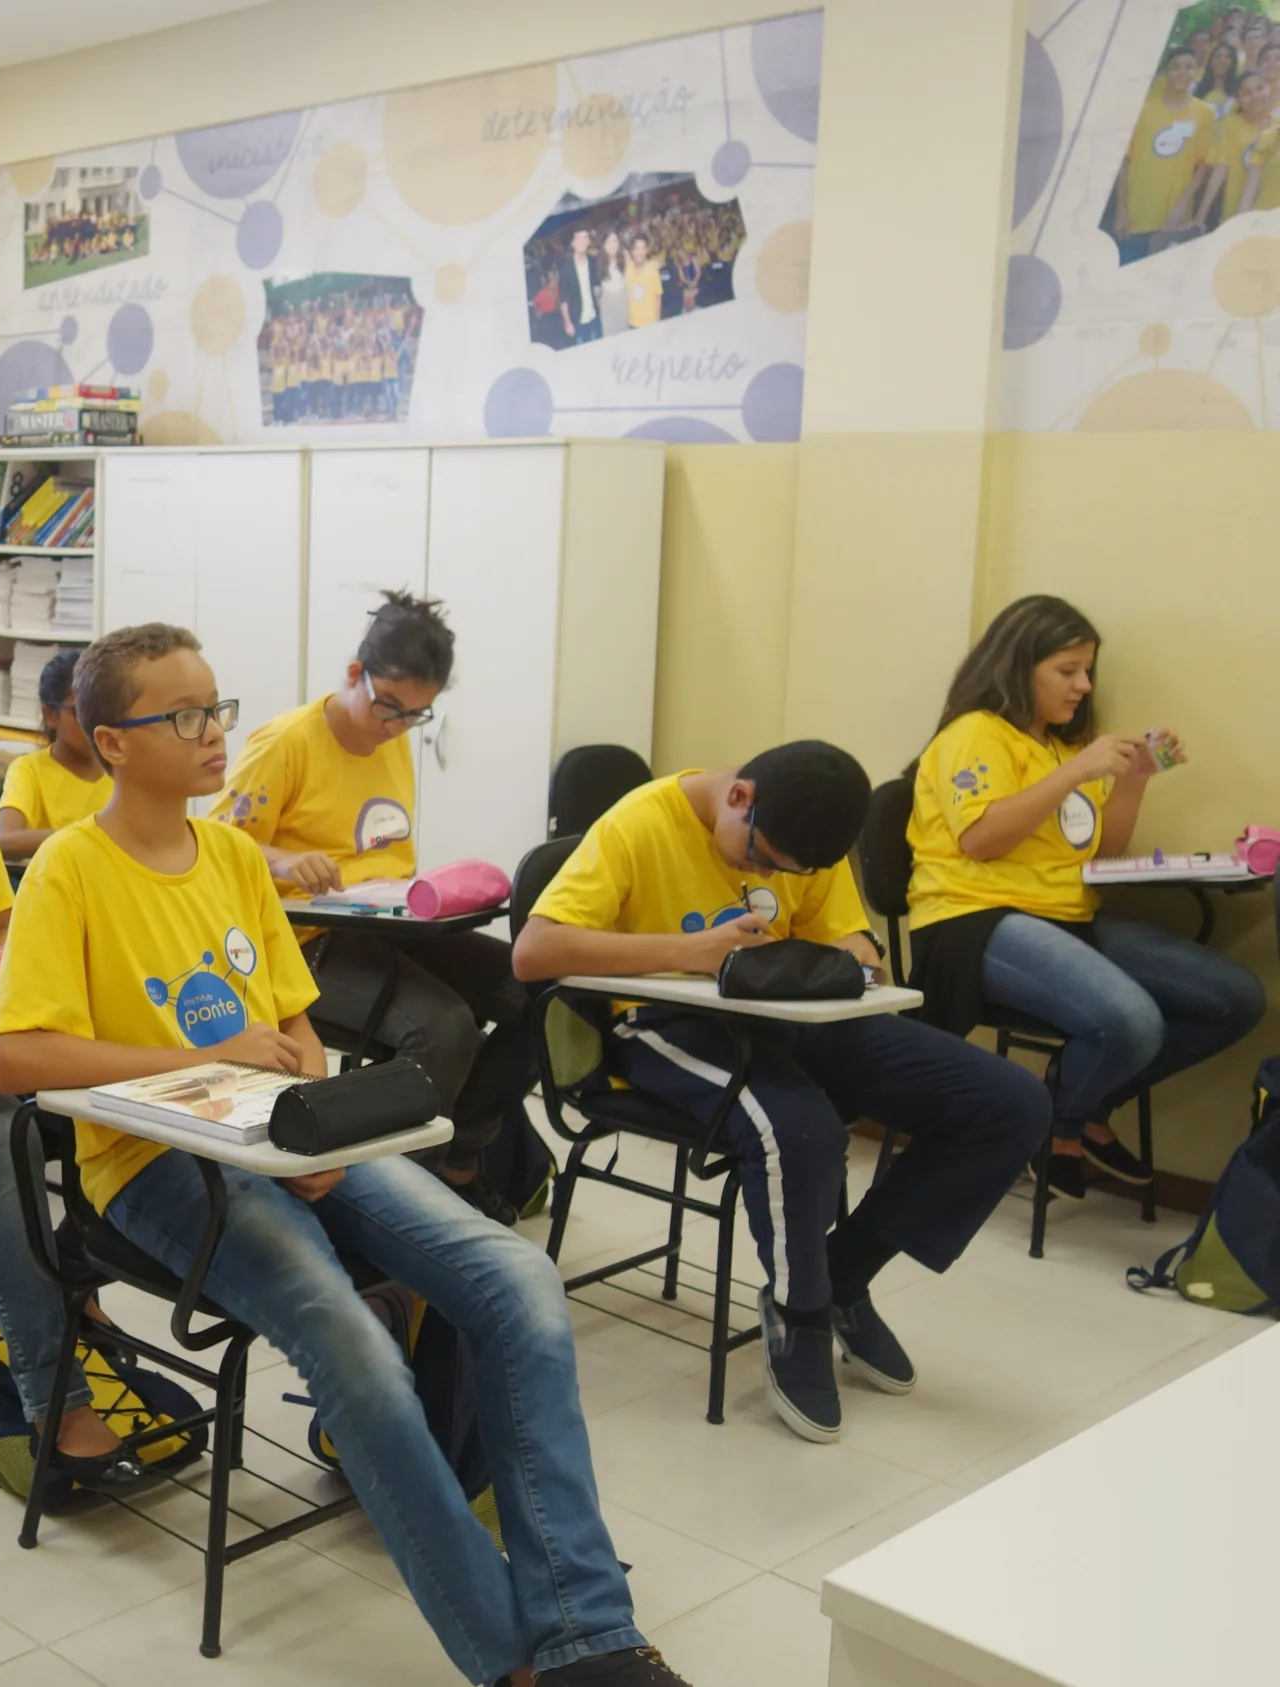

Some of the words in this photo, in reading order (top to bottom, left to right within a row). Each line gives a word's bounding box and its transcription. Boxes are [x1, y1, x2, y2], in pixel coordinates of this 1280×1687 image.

[612, 344, 749, 401] respeito
[19, 411, 65, 430] MASTER
[184, 998, 238, 1032] ponte
